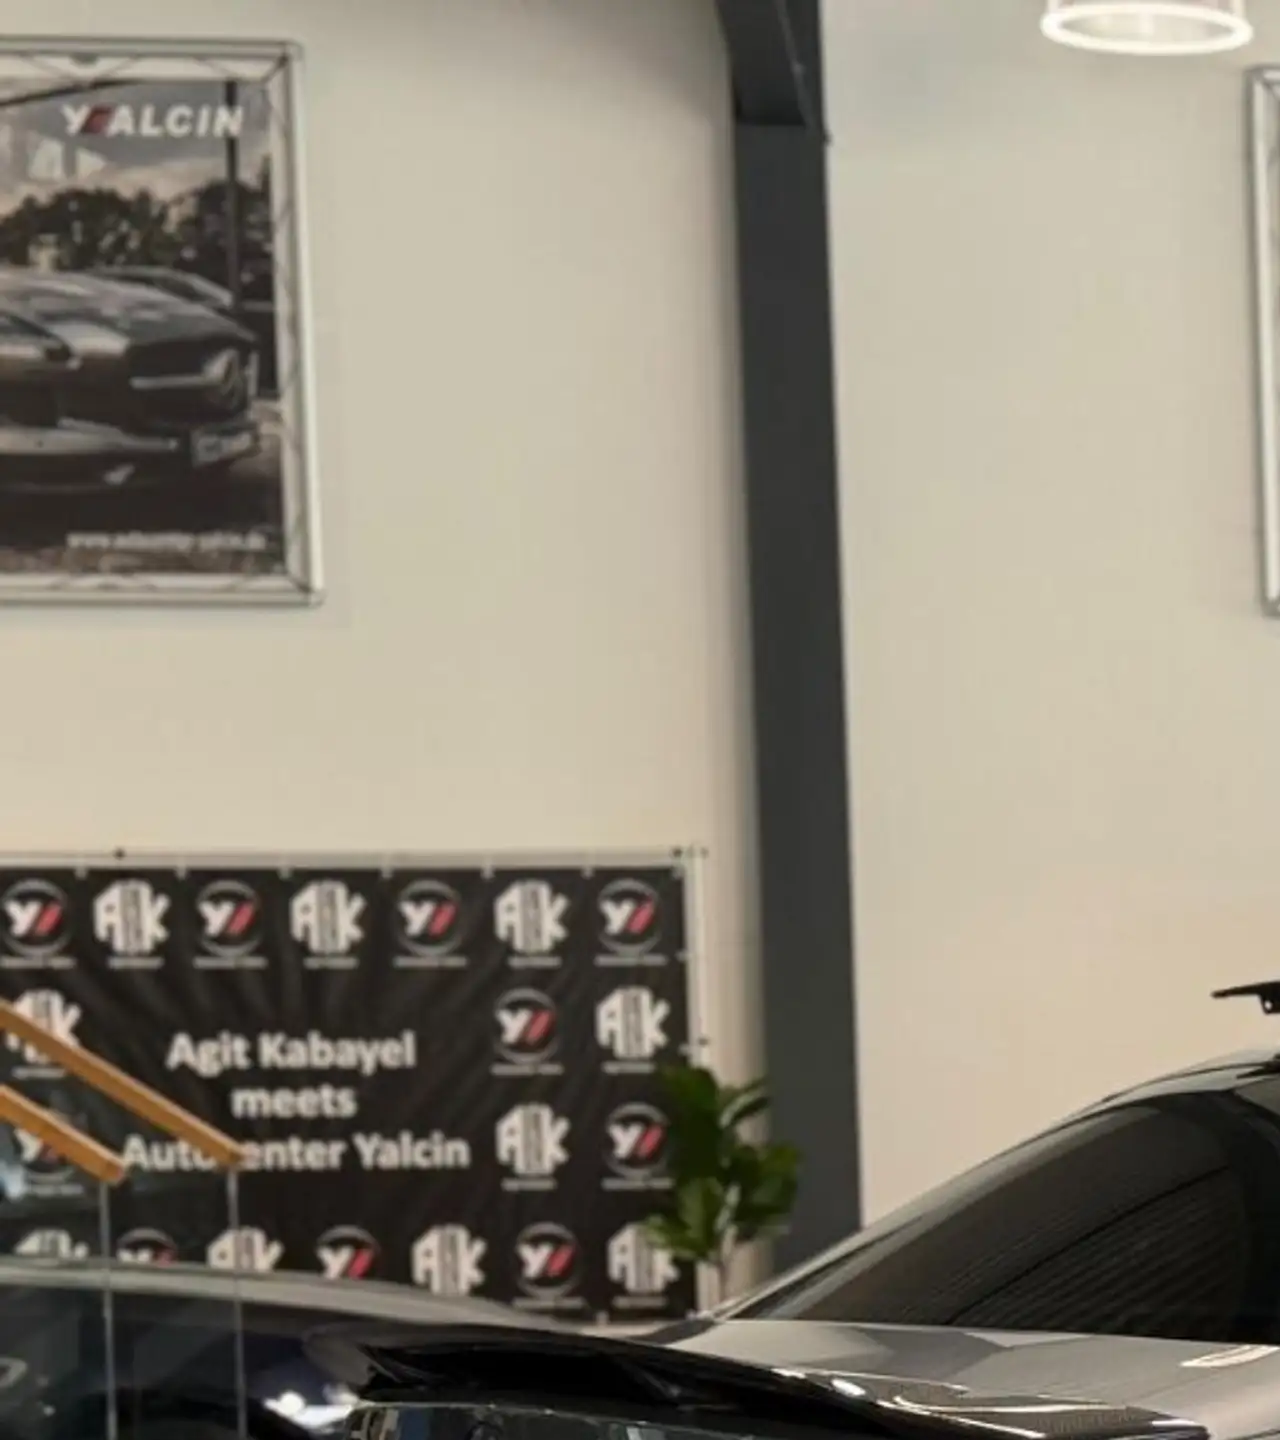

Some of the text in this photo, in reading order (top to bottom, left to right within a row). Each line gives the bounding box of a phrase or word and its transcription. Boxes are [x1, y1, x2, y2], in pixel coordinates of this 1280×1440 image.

[166, 1030, 416, 1077] Agit Kabayel
[231, 1083, 358, 1118] meets
[124, 1130, 471, 1171] Autoenter Yalcin
